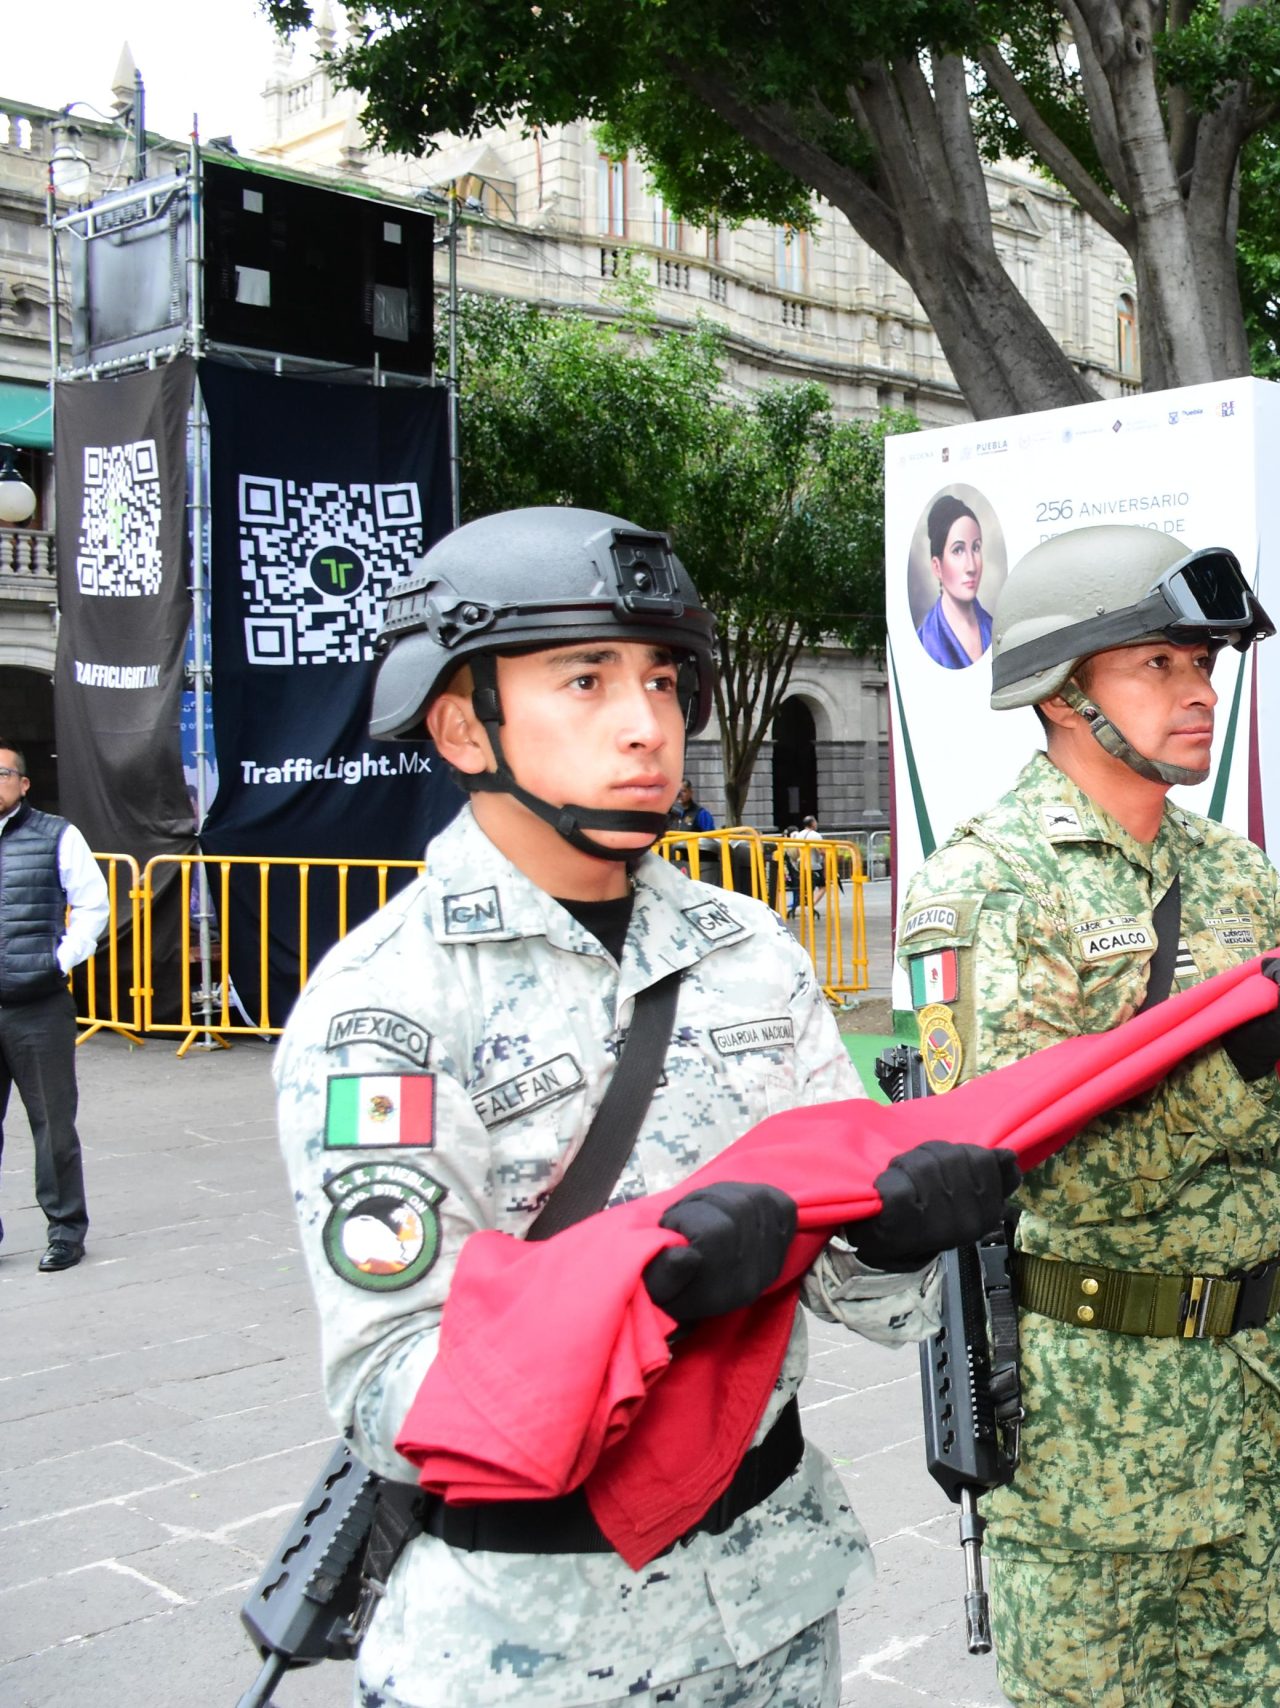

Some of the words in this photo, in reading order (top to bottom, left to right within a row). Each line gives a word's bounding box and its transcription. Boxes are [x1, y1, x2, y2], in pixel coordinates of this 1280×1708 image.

[976, 439, 1008, 452] PUEBLA
[1036, 499, 1073, 523] 256
[1079, 491, 1189, 518] ANIVERSARIO
[1164, 518, 1185, 534] DE
[240, 751, 432, 784] TrafficLight.Mx
[451, 900, 497, 924] GN
[699, 908, 735, 932] GN
[905, 909, 955, 934] MEXICO
[1089, 932, 1146, 954] ACALCO
[333, 1015, 424, 1054] MEXICO
[717, 1028, 760, 1048] GUARDIA
[476, 1066, 563, 1120] FALFAN
[374, 1165, 438, 1201] PUEBLA
